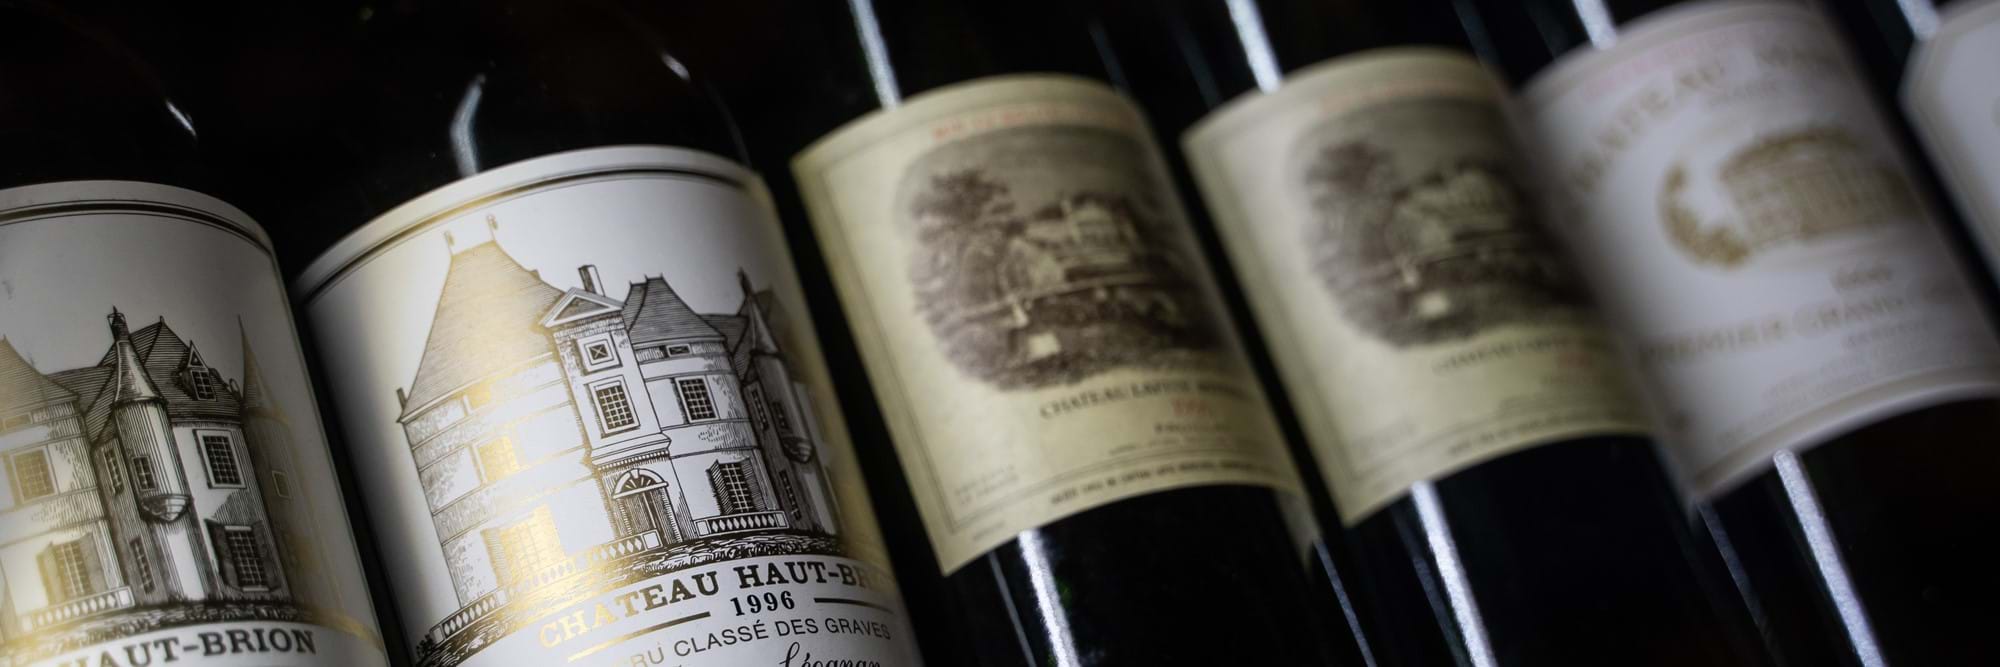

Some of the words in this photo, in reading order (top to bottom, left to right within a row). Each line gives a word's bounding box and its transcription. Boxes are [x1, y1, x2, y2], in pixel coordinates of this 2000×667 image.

[539, 571, 720, 648] CHATEAU
[733, 561, 888, 591] HAUT-BR
[730, 590, 795, 617] 1996
[630, 644, 665, 667] RU
[674, 619, 769, 657] CLASSÉ
[775, 618, 819, 637] DES
[825, 617, 891, 640] GRAVES
